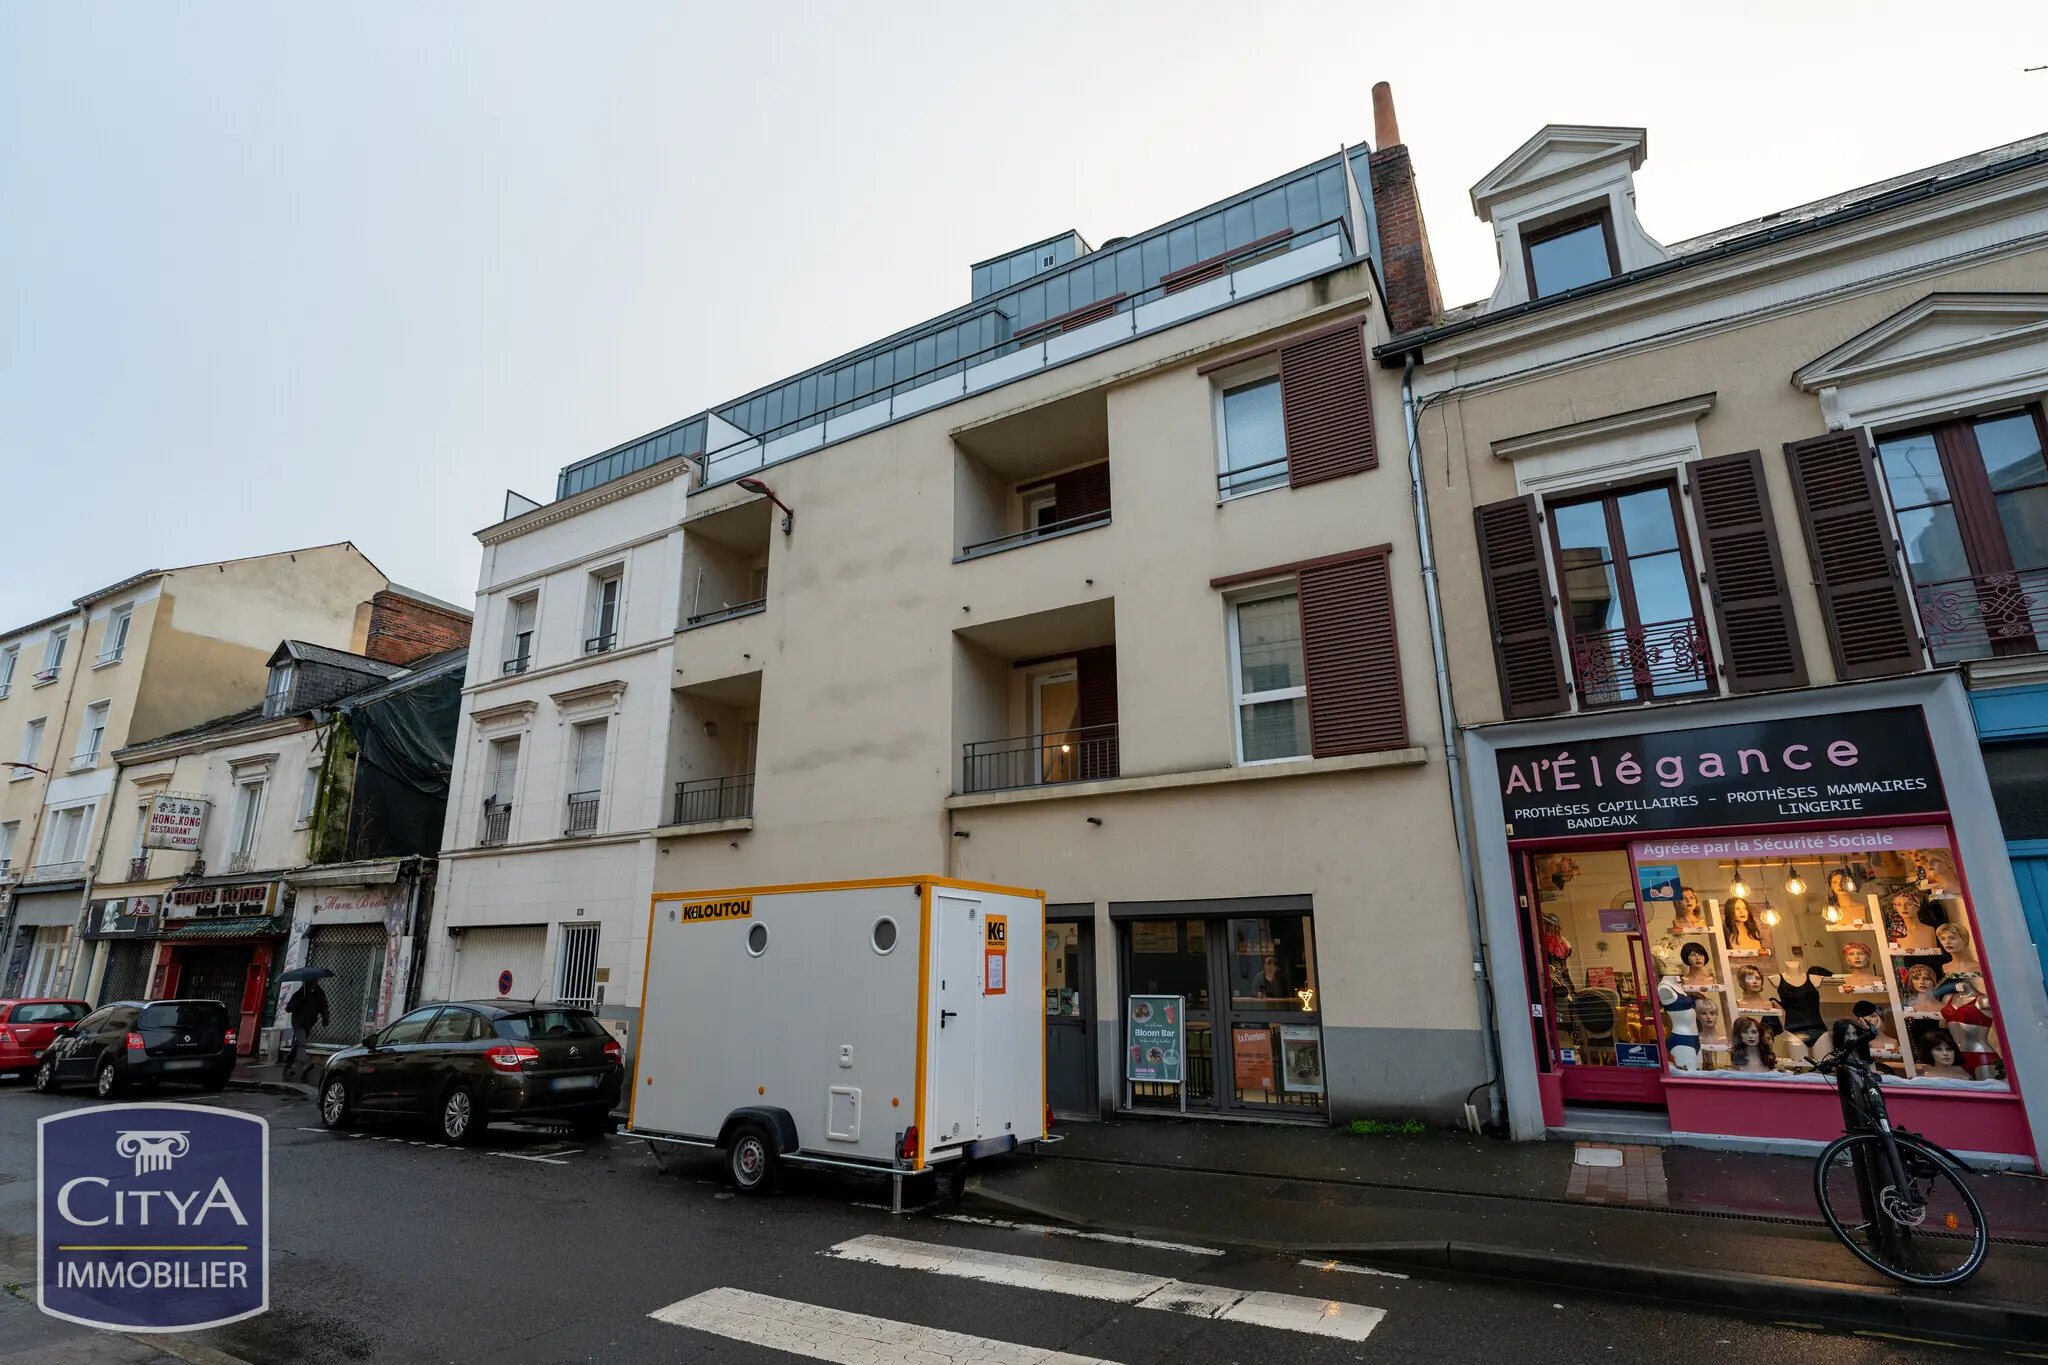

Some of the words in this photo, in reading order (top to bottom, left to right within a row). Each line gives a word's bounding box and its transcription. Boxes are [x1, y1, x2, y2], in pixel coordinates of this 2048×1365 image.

[1515, 803, 1590, 819] PROTHÈSES
[1598, 795, 1699, 813] CAPILLAIRES
[1727, 786, 1818, 803] PROTHÈSES
[1827, 777, 1928, 796] MAMMAIRES
[1778, 798, 1864, 815] LINGERIE
[1567, 814, 1638, 829] BANDEAUX
[150, 825, 191, 835] RESTAURANT
[171, 836, 198, 845] CHINOIS
[1643, 840, 1700, 857] Agréée
[1704, 843, 1730, 856] par
[1735, 838, 1750, 852] la
[1754, 835, 1824, 851] Sécurité
[1828, 831, 1894, 848] Sociale
[173, 891, 214, 906] HONG
[219, 886, 266, 902] KONG
[1135, 1029, 1160, 1037] Bloom
[1161, 1029, 1175, 1037] Bar
